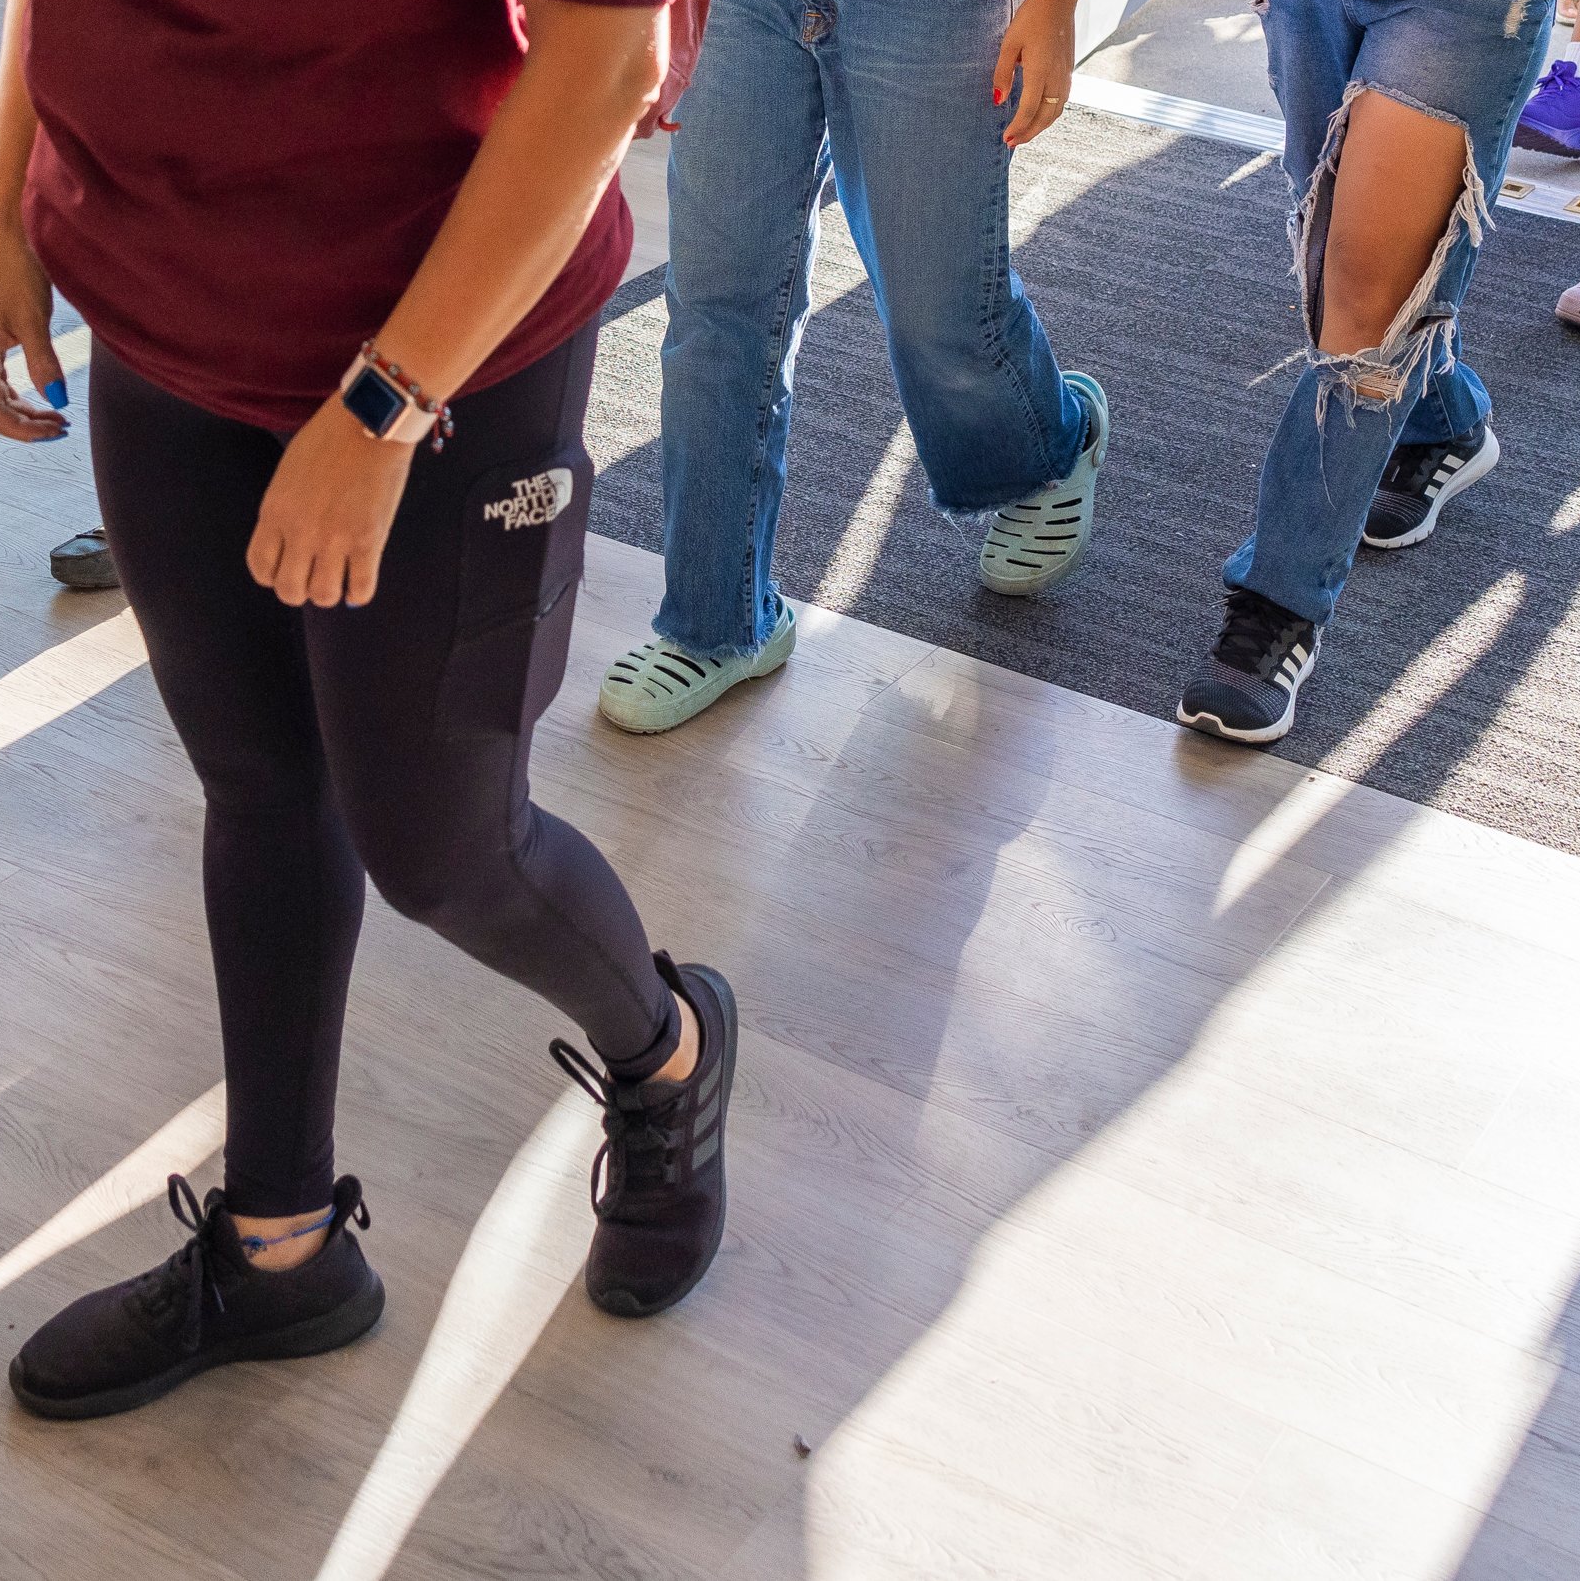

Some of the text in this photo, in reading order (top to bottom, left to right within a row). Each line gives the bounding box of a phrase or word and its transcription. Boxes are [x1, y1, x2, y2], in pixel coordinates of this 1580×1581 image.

[511, 472, 552, 498] THE
[483, 487, 557, 522] NORTH
[504, 506, 557, 532] FACE
